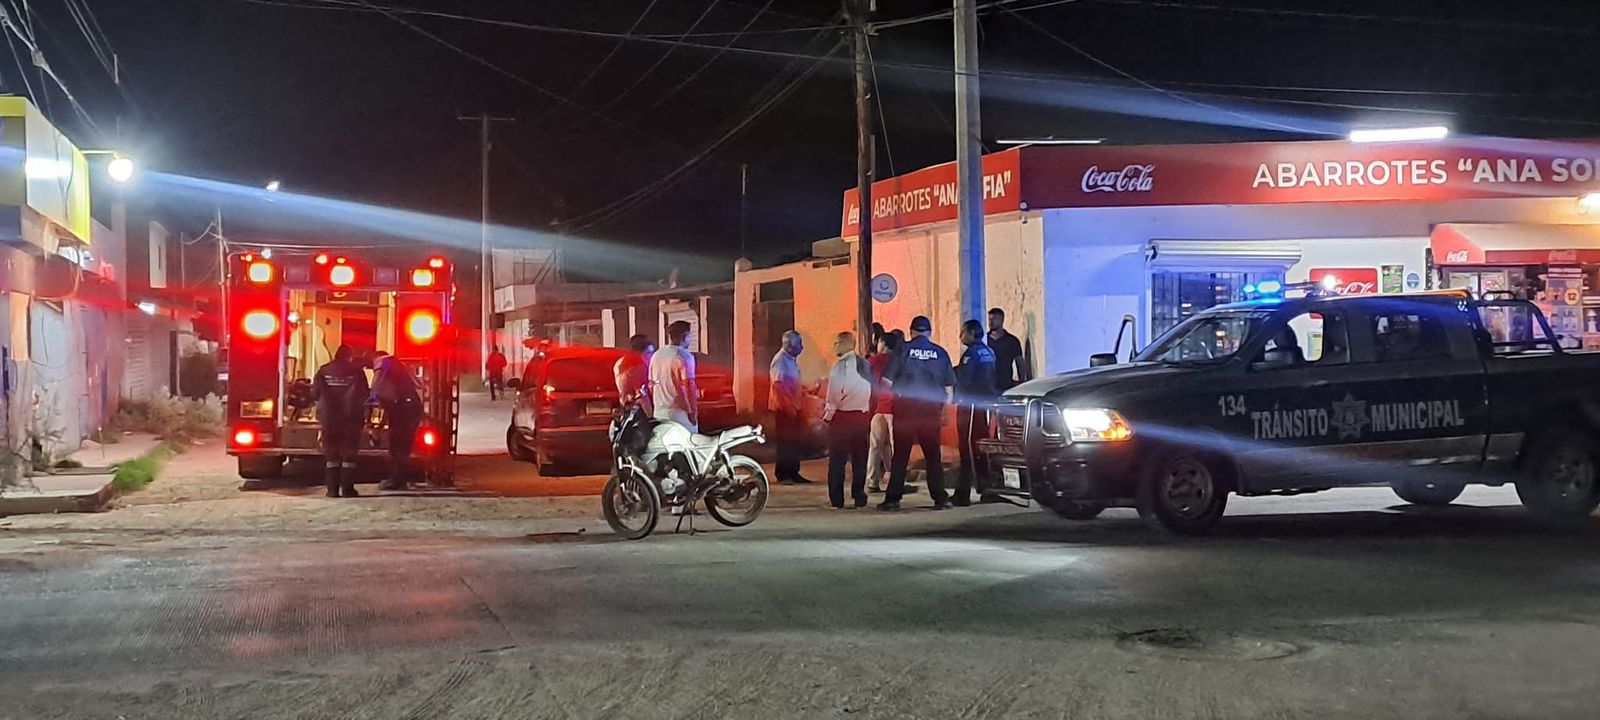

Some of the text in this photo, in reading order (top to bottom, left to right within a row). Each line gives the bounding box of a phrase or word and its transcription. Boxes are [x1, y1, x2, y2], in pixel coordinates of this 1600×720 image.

[1081, 164, 1156, 193] Coca-Cola
[1253, 160, 1447, 188] ABARROTES
[1458, 158, 1542, 183] “ANA
[873, 188, 931, 219] ABARROTES
[1218, 395, 1246, 416] 134
[1250, 400, 1464, 440] TRÁNSITO MUNICIPAL
